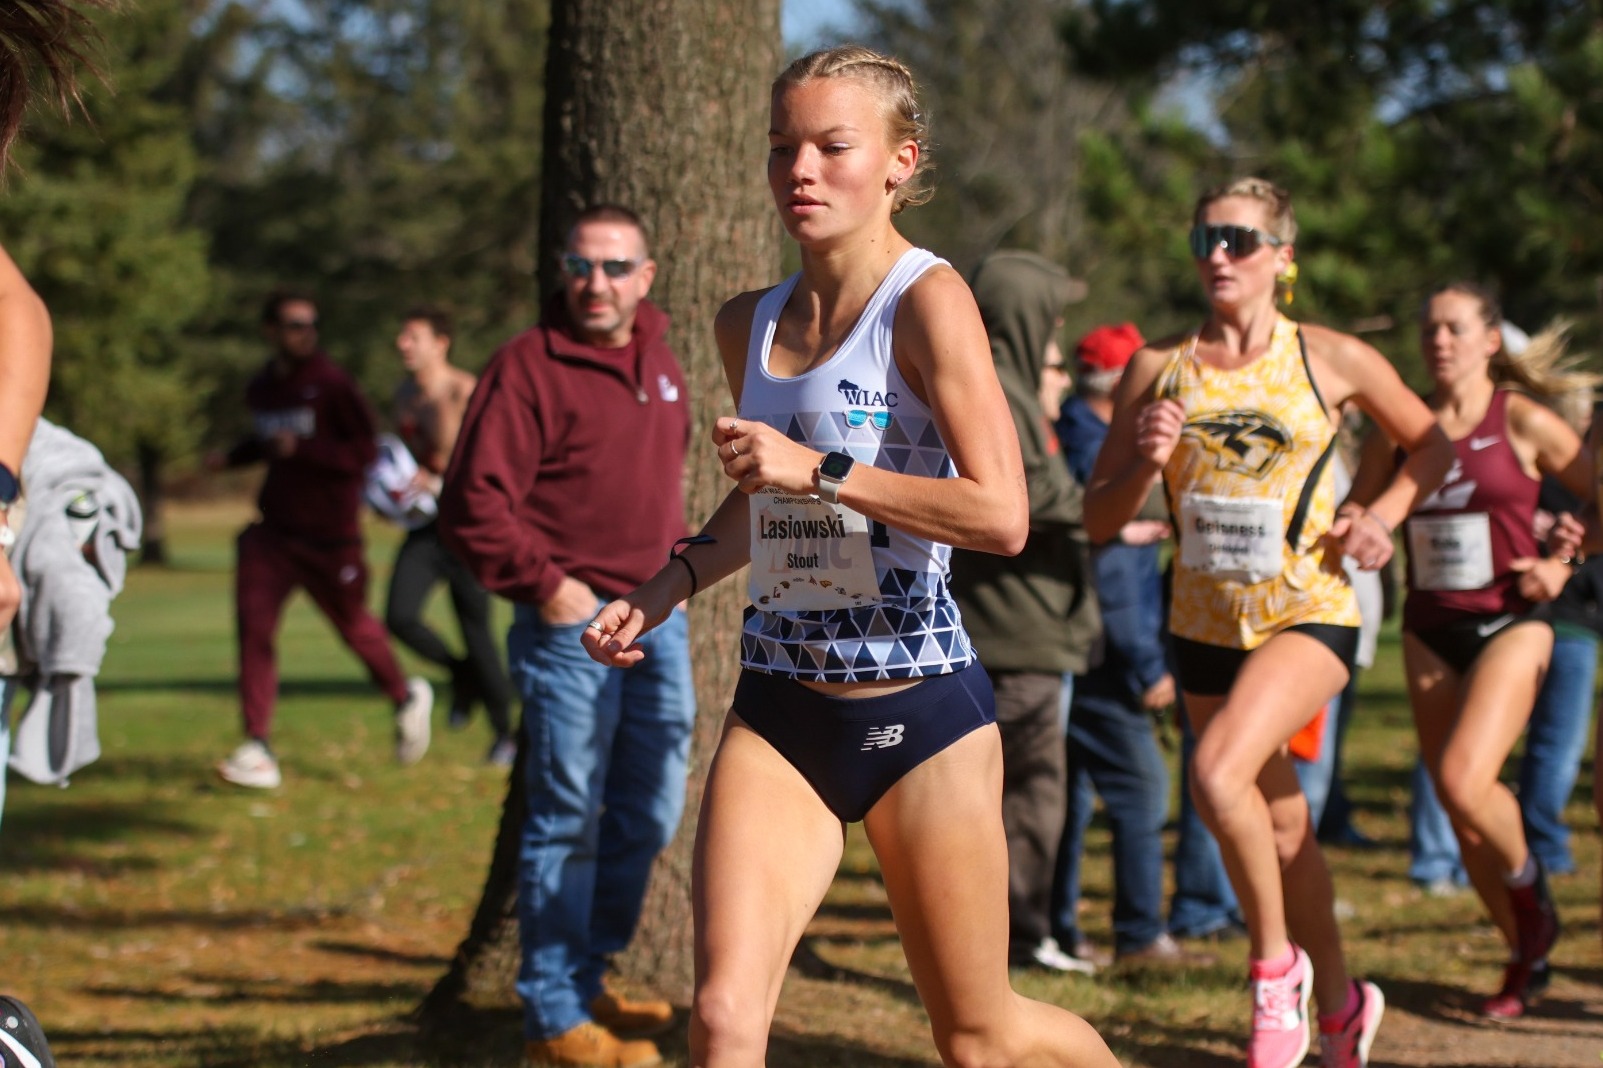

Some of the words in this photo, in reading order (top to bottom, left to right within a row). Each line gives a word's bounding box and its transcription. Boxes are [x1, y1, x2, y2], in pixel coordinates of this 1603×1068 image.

[839, 388, 898, 408] WIAC
[760, 514, 846, 540] Lasiowski
[787, 553, 819, 569] Stout
